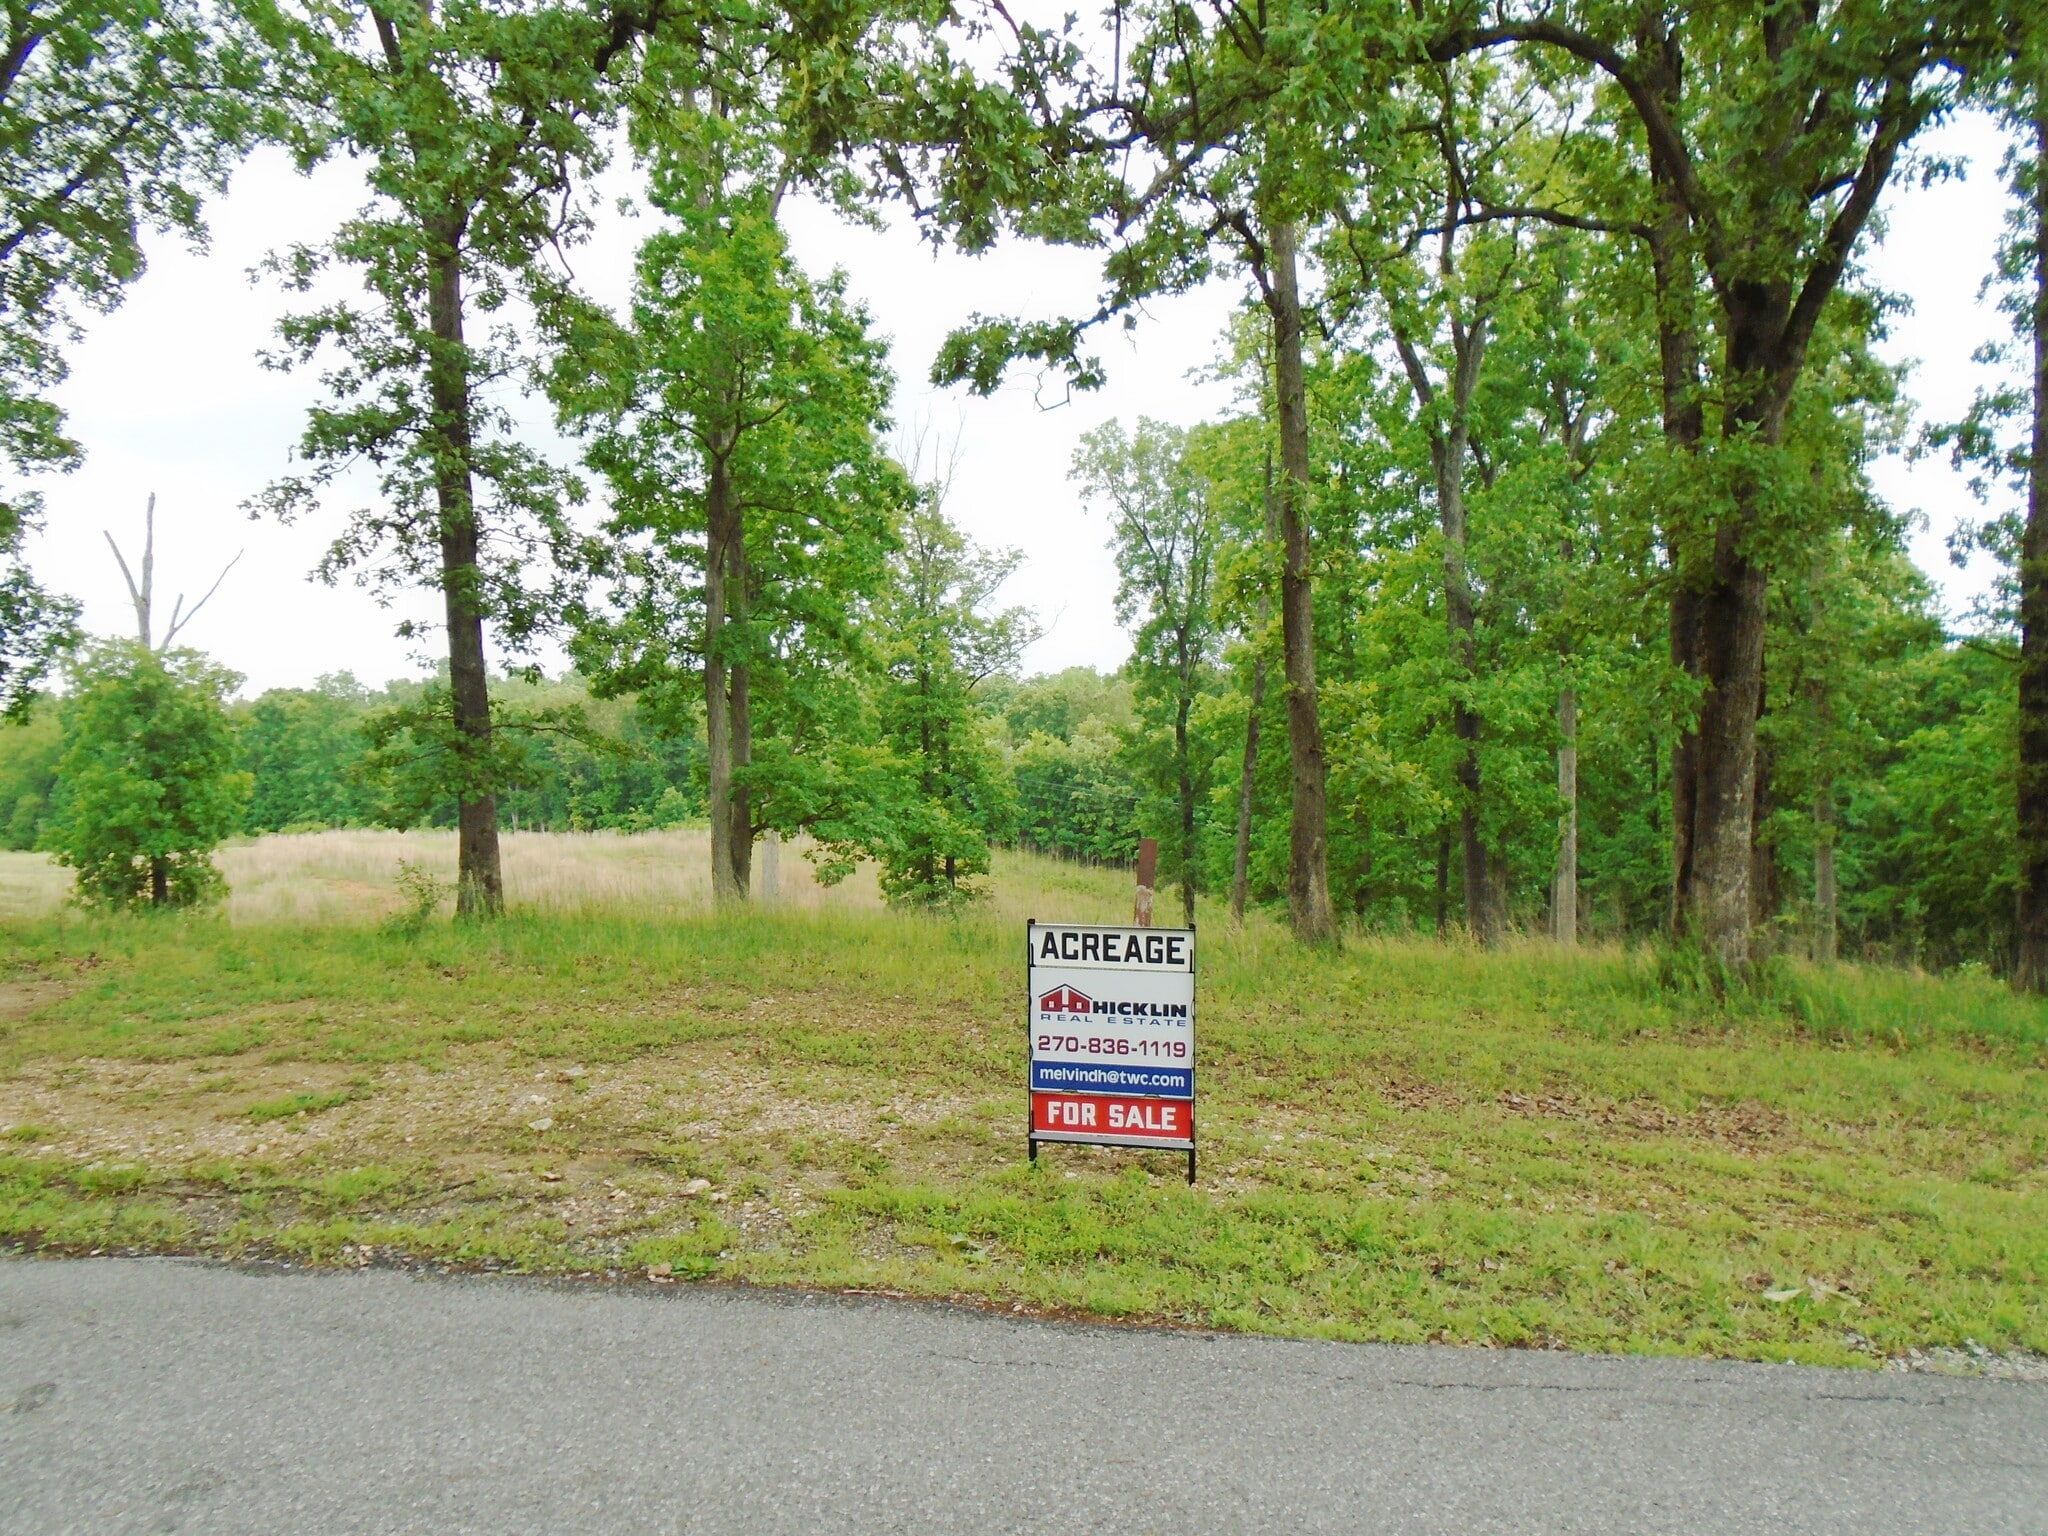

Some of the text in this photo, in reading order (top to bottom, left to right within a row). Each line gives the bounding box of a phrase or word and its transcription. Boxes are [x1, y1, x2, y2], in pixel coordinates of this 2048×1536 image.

[1040, 931, 1185, 965] ACREAGE
[1040, 1013, 1187, 1027] REAL ESTATE
[1093, 1001, 1187, 1018] HICKLIN
[1038, 1035, 1186, 1058] 270-836-1119
[1039, 1067, 1185, 1088] melvindh@twc.com
[1047, 1101, 1177, 1131] FOR SALE
